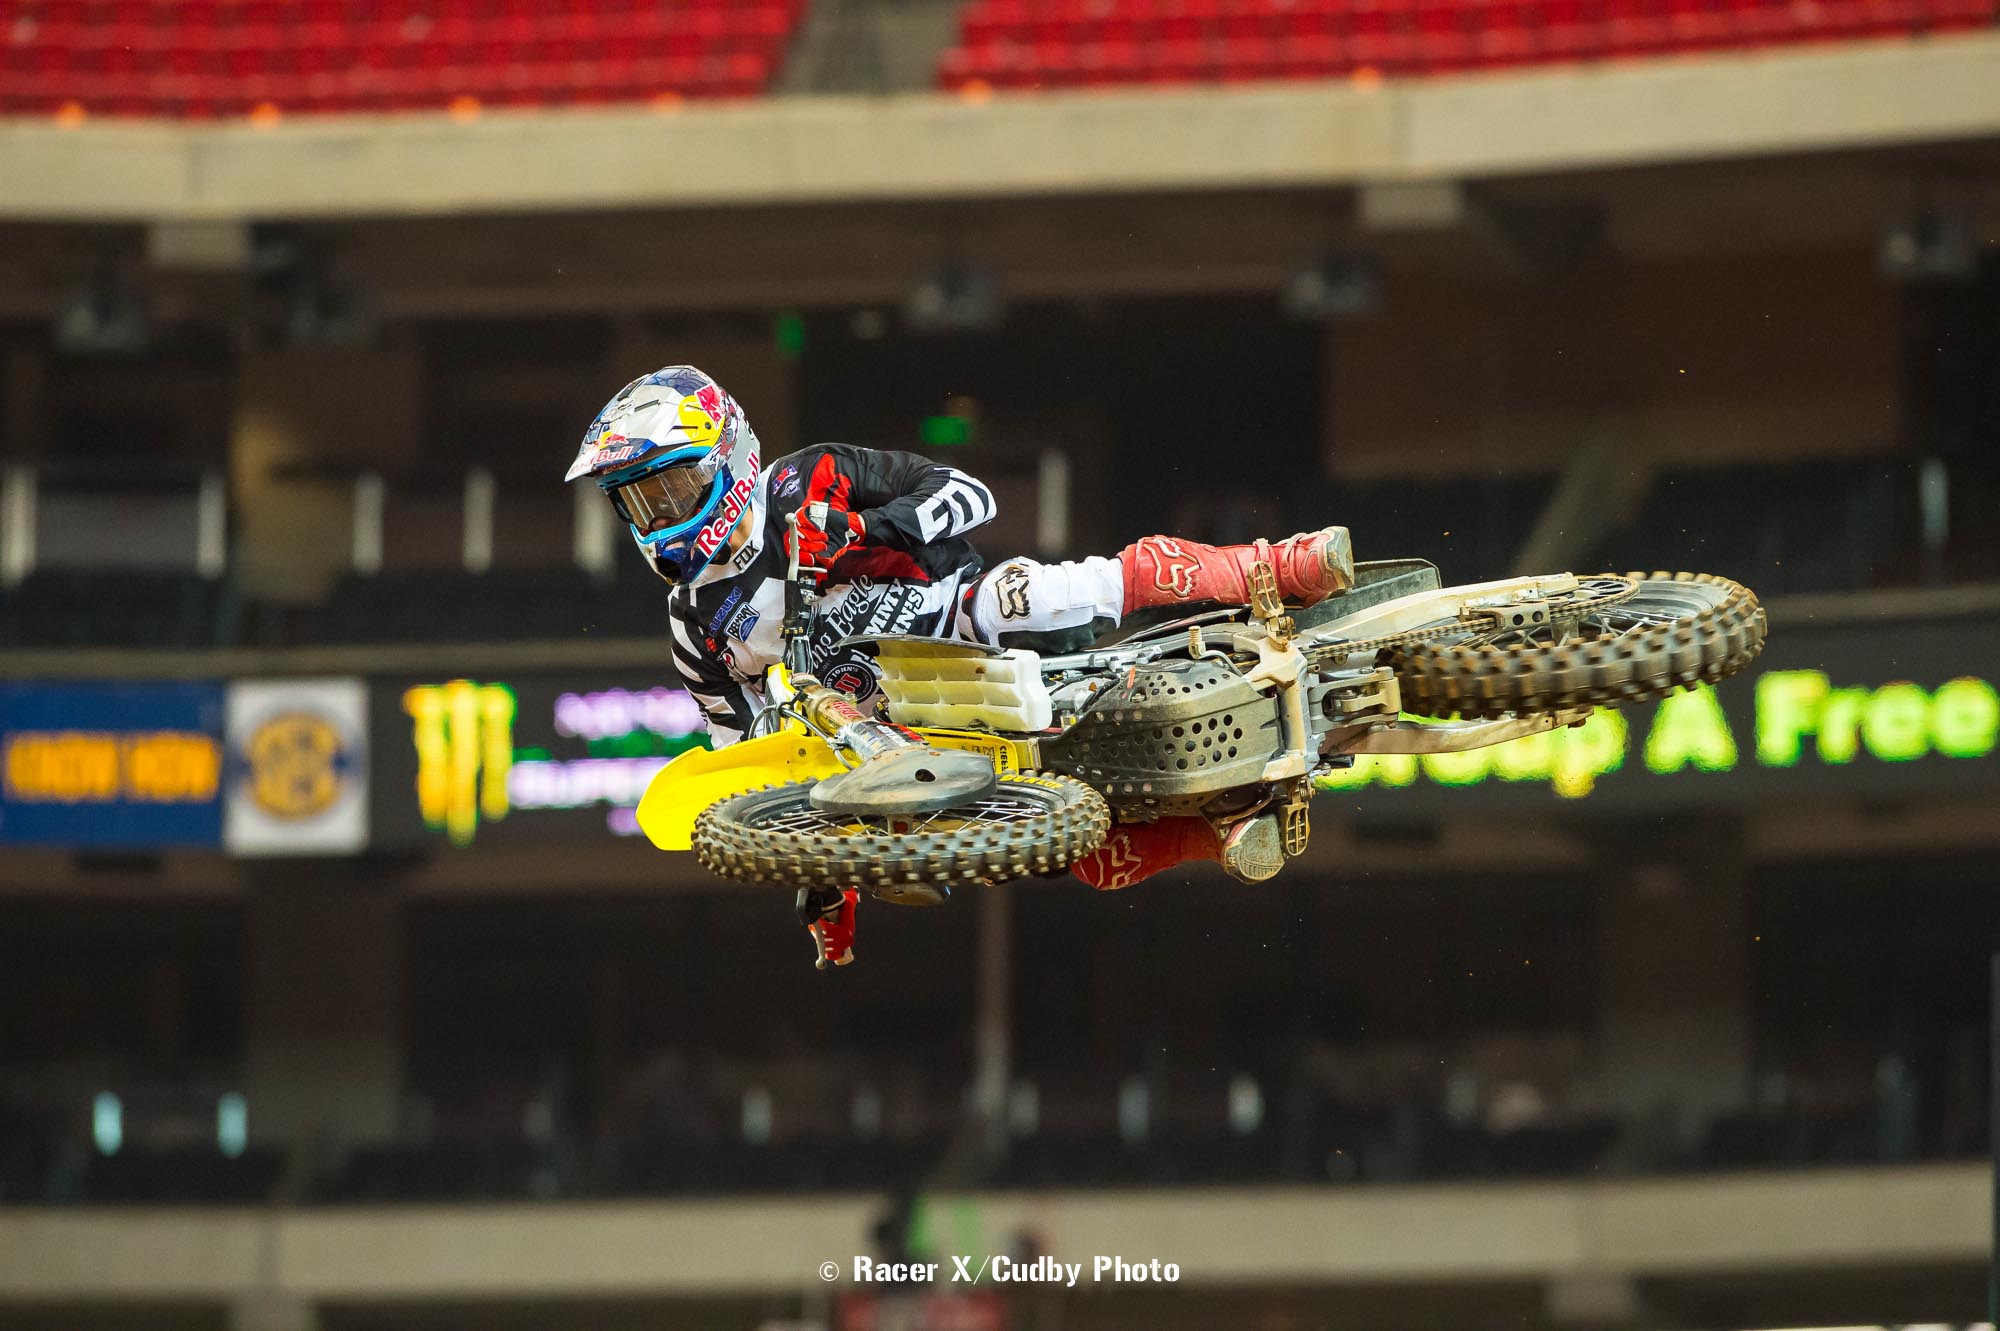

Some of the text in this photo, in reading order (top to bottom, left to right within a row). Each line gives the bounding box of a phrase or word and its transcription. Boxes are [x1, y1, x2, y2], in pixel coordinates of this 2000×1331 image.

[597, 446, 634, 463] Bull
[696, 451, 760, 557] Red Bull
[732, 540, 760, 571] FOX
[825, 574, 875, 638] Eagle
[862, 577, 904, 635] MMY
[1643, 681, 1738, 774] A
[1754, 669, 1998, 767] Free
